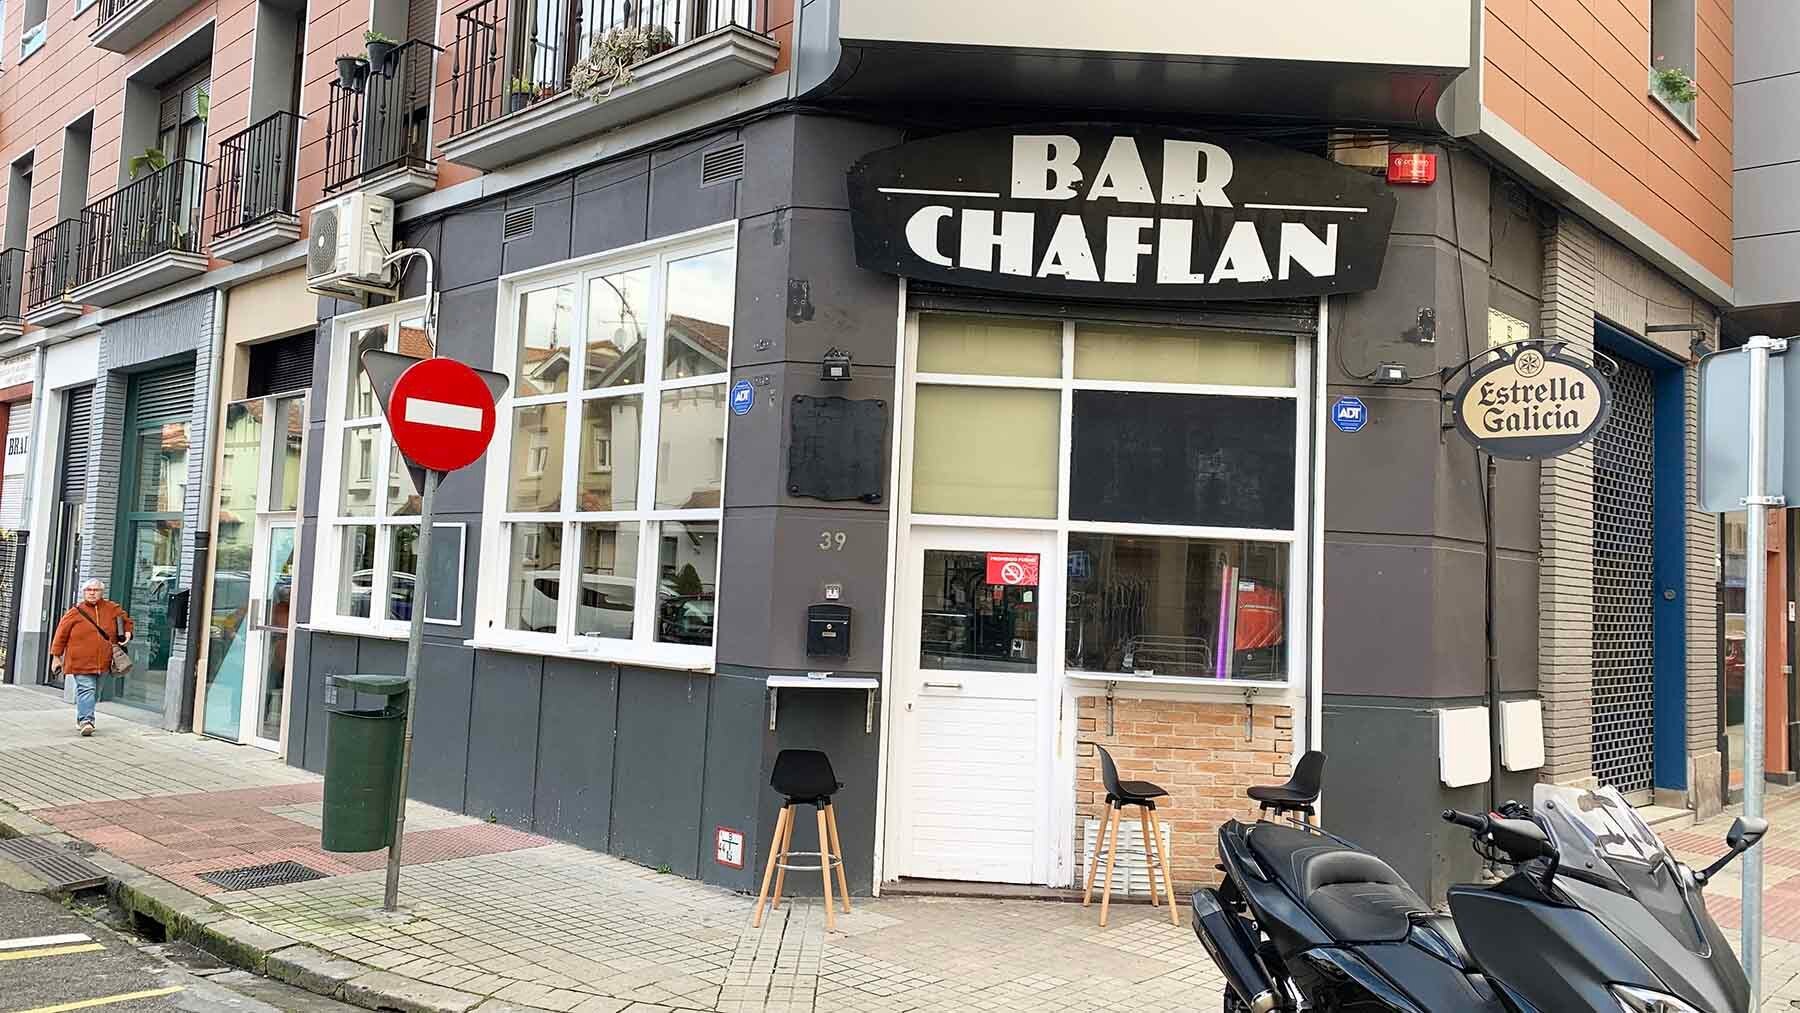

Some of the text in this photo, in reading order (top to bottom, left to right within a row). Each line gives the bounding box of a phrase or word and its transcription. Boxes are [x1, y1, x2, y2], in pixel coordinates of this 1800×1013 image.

[1010, 134, 1234, 208] BAR
[905, 205, 1339, 285] CHAFLAN
[735, 390, 749, 401] ADT
[1478, 377, 1585, 406] Estrella
[1340, 407, 1361, 419] ADT
[1483, 404, 1580, 432] Galicia
[820, 531, 847, 551] 39
